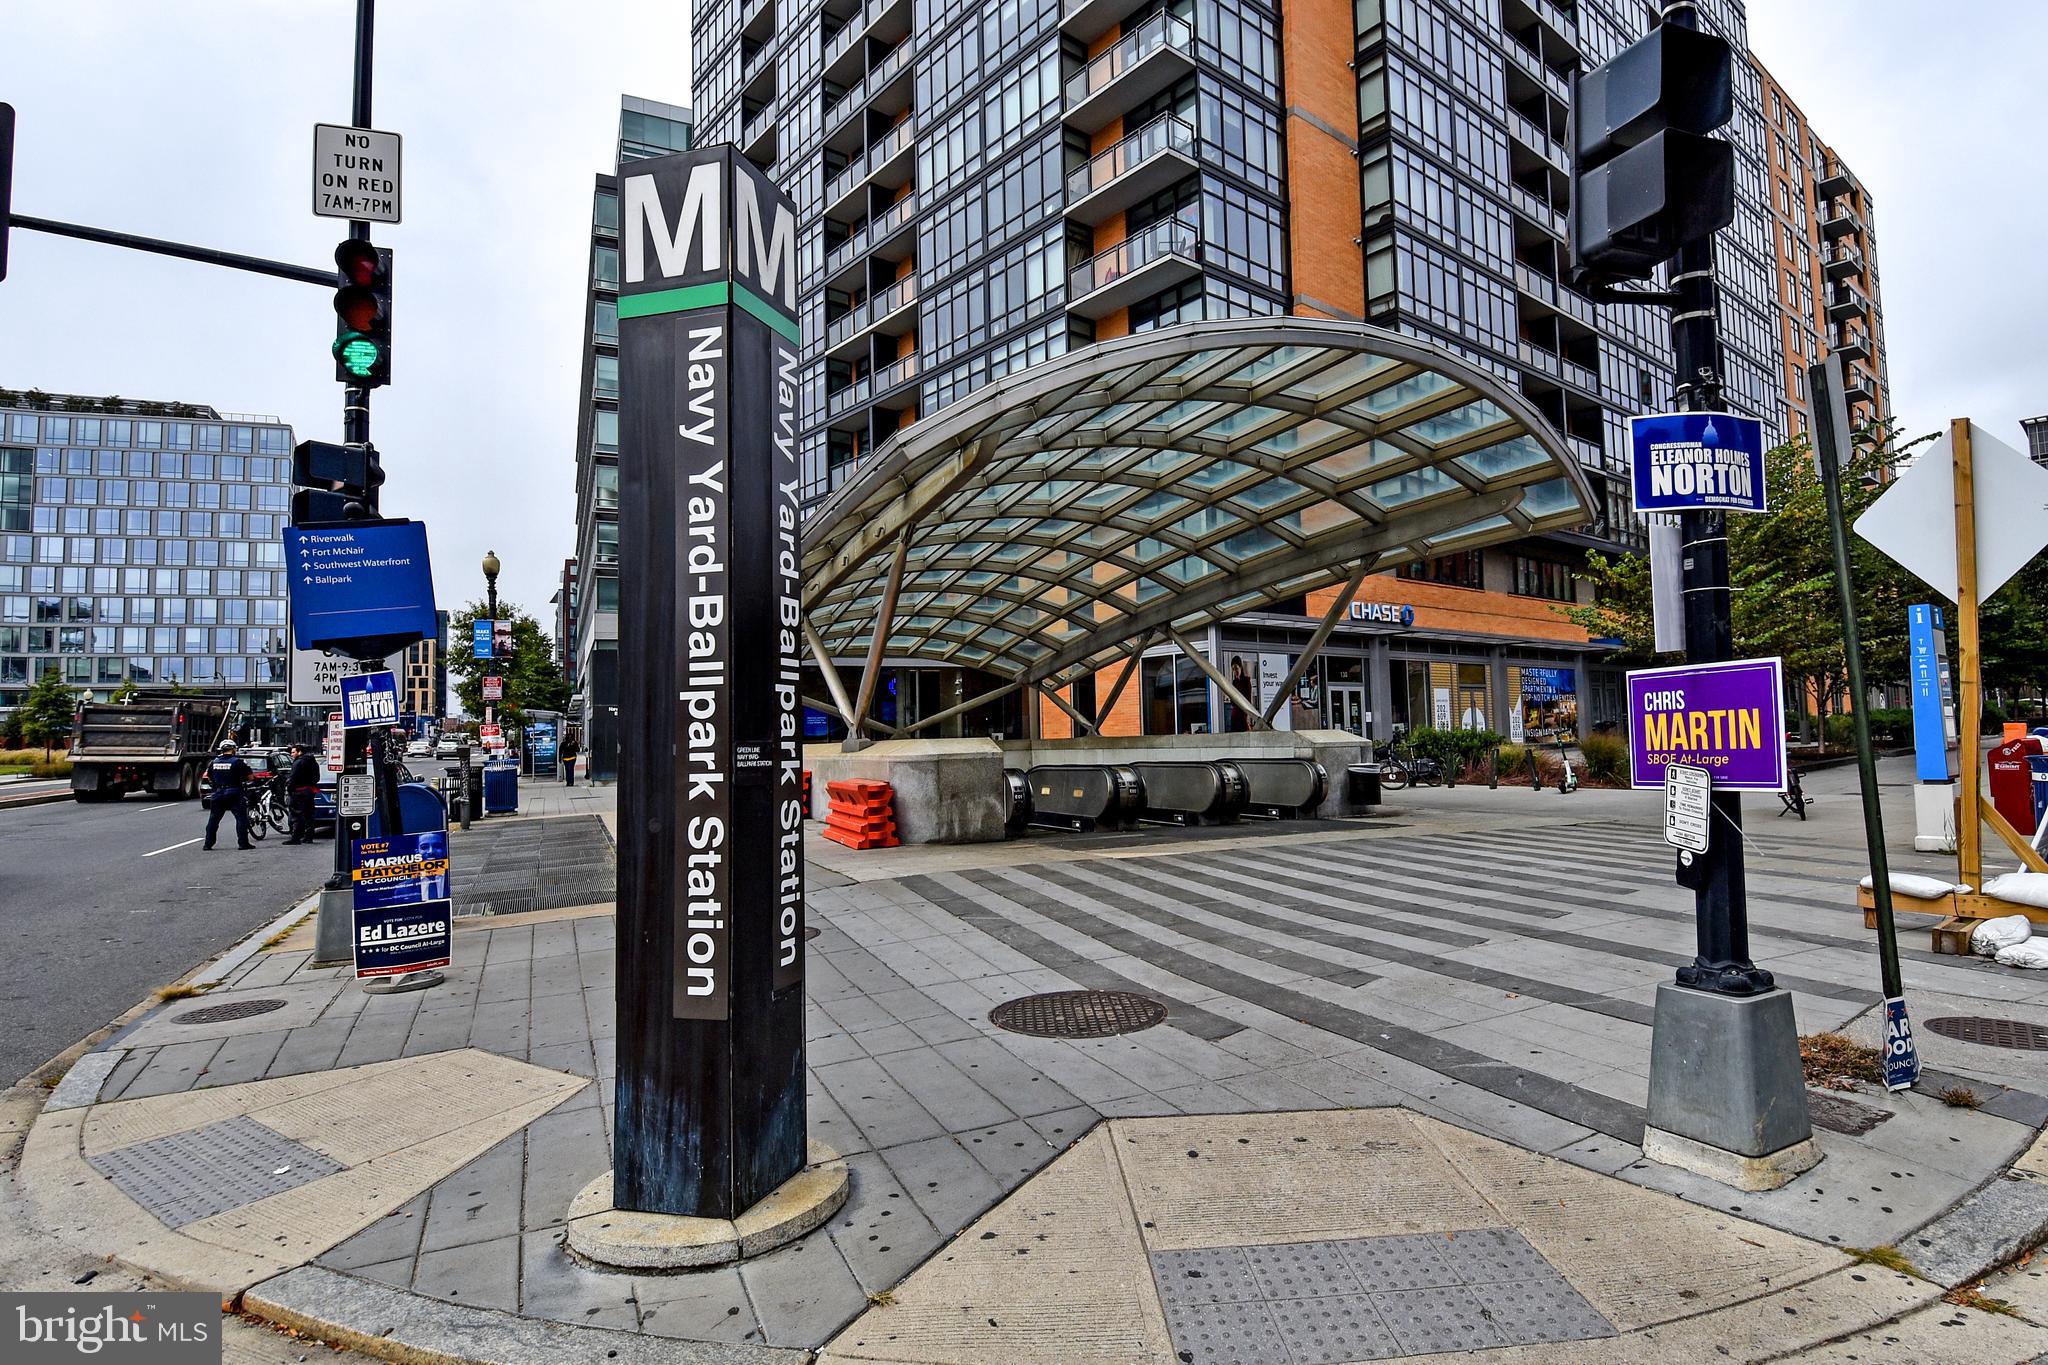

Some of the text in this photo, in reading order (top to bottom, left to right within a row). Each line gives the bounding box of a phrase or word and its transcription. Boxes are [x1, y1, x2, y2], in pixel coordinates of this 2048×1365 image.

[346, 134, 370, 149] NO
[334, 153, 383, 172] TURN
[322, 173, 393, 193] ON RED
[322, 193, 392, 214] 7AM-7PM
[625, 161, 720, 283] M
[735, 165, 796, 313] M
[1650, 441, 1702, 450] CONGRESSWOMAN
[1650, 448, 1750, 468] ELEANOR HOLMES
[1651, 463, 1753, 498] NORTON
[310, 533, 355, 543] Riverwalk
[312, 546, 365, 557] Fort McNair
[313, 557, 411, 570] Southwest Waterfront
[315, 574, 352, 585] Ballpark
[1351, 601, 1401, 622] CHASE
[679, 326, 725, 996] Navy Yard-Ballpark Station
[774, 346, 801, 967] Navy Yard-Ballpark Station
[1262, 671, 1278, 679] Invest
[1521, 677, 1546, 686] DESIGNED
[1262, 681, 1274, 689] your
[1521, 693, 1576, 702] TOP-NOTCH AMENITIES
[1644, 689, 1685, 712] CHRIS
[349, 699, 395, 721] NORTON
[1644, 708, 1761, 751] MARTIN
[1680, 753, 1729, 767] At-Large
[360, 860, 446, 879] BATCHELOR
[364, 853, 423, 868] MARKUS
[374, 875, 411, 884] COUNCIL
[360, 920, 446, 941] Ed Lazere
[400, 942, 421, 951] Council
[422, 939, 445, 948] At-Large
